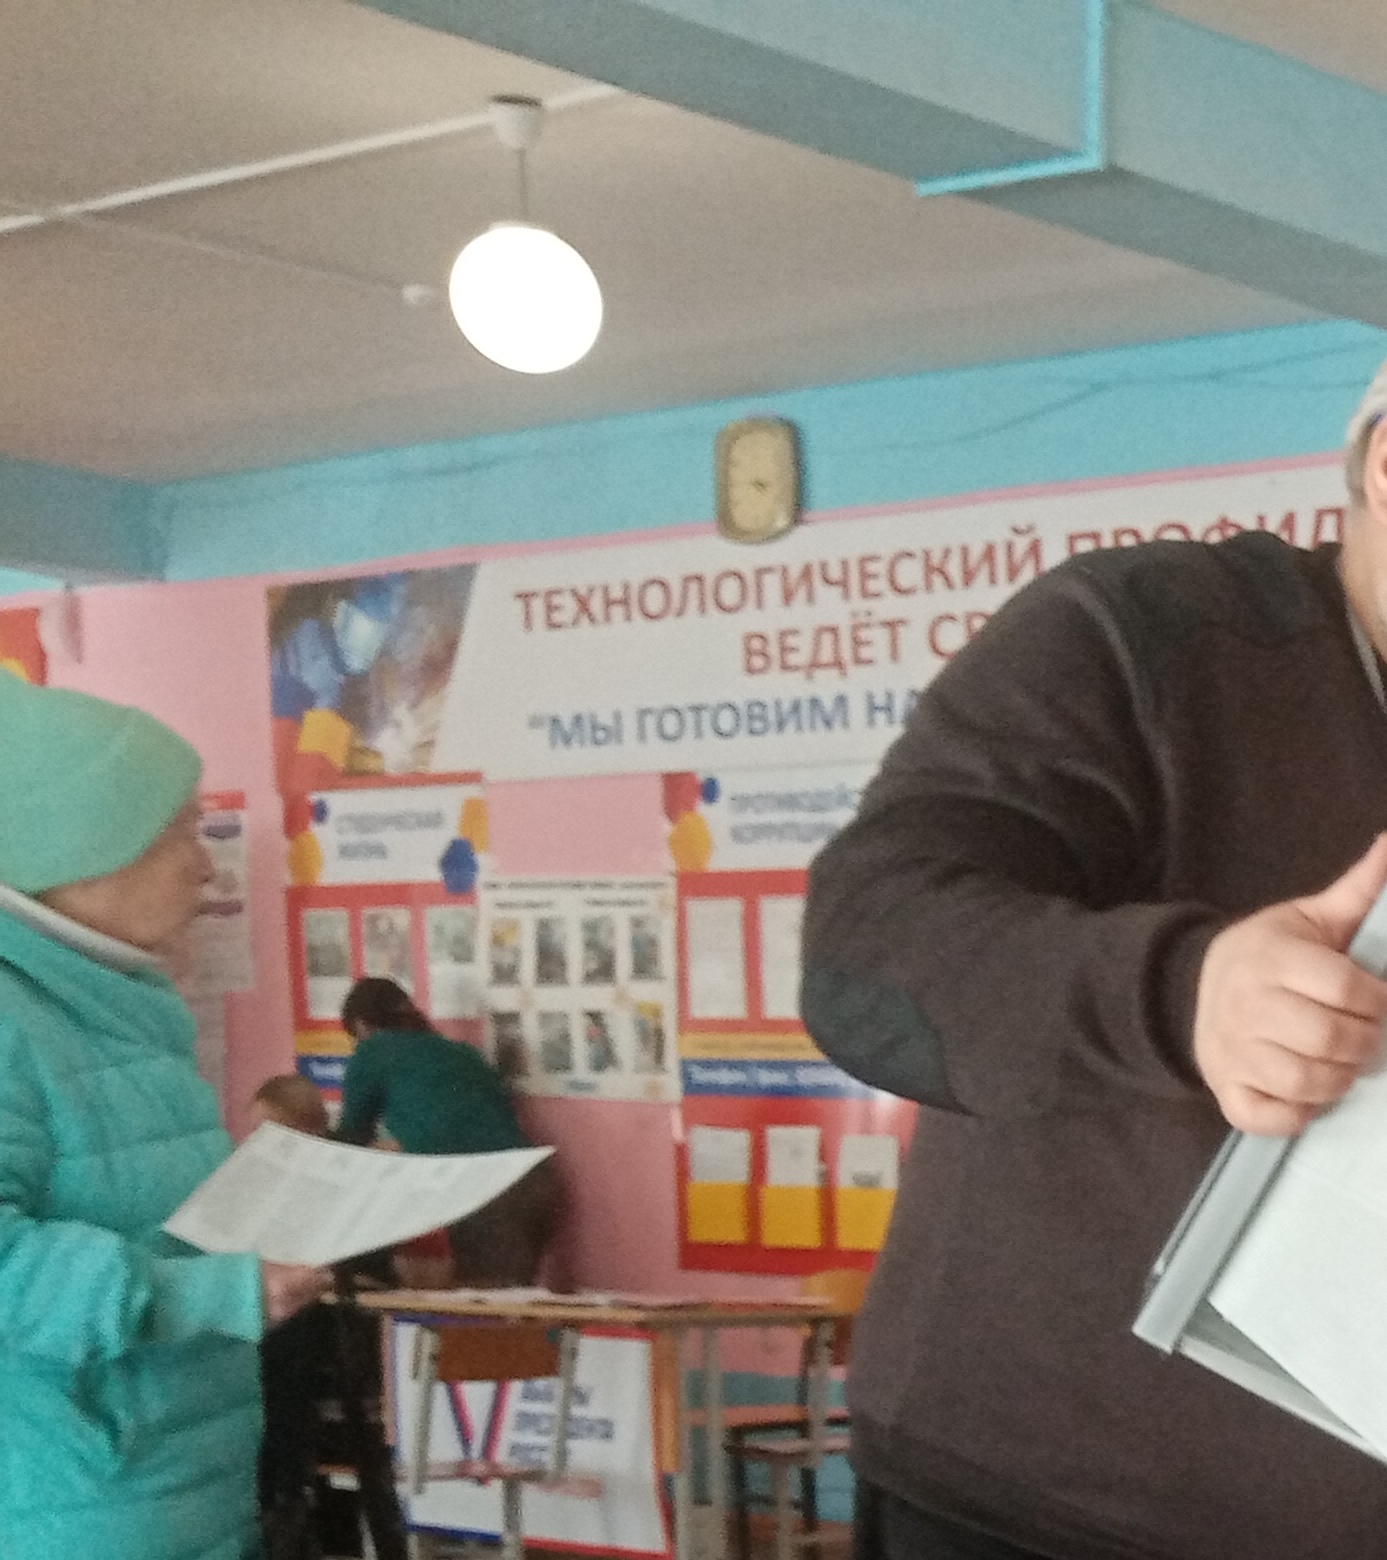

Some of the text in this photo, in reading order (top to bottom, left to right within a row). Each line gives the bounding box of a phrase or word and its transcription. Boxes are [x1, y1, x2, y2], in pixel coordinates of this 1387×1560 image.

[515, 523, 1044, 633] ТЕХНОЛОГИЧЕСКИЙ
[1067, 506, 1345, 557] ПРОФИЛ
[741, 609, 907, 681] ВЕДЁТ
[636, 692, 850, 746] ГОТОВИМ
